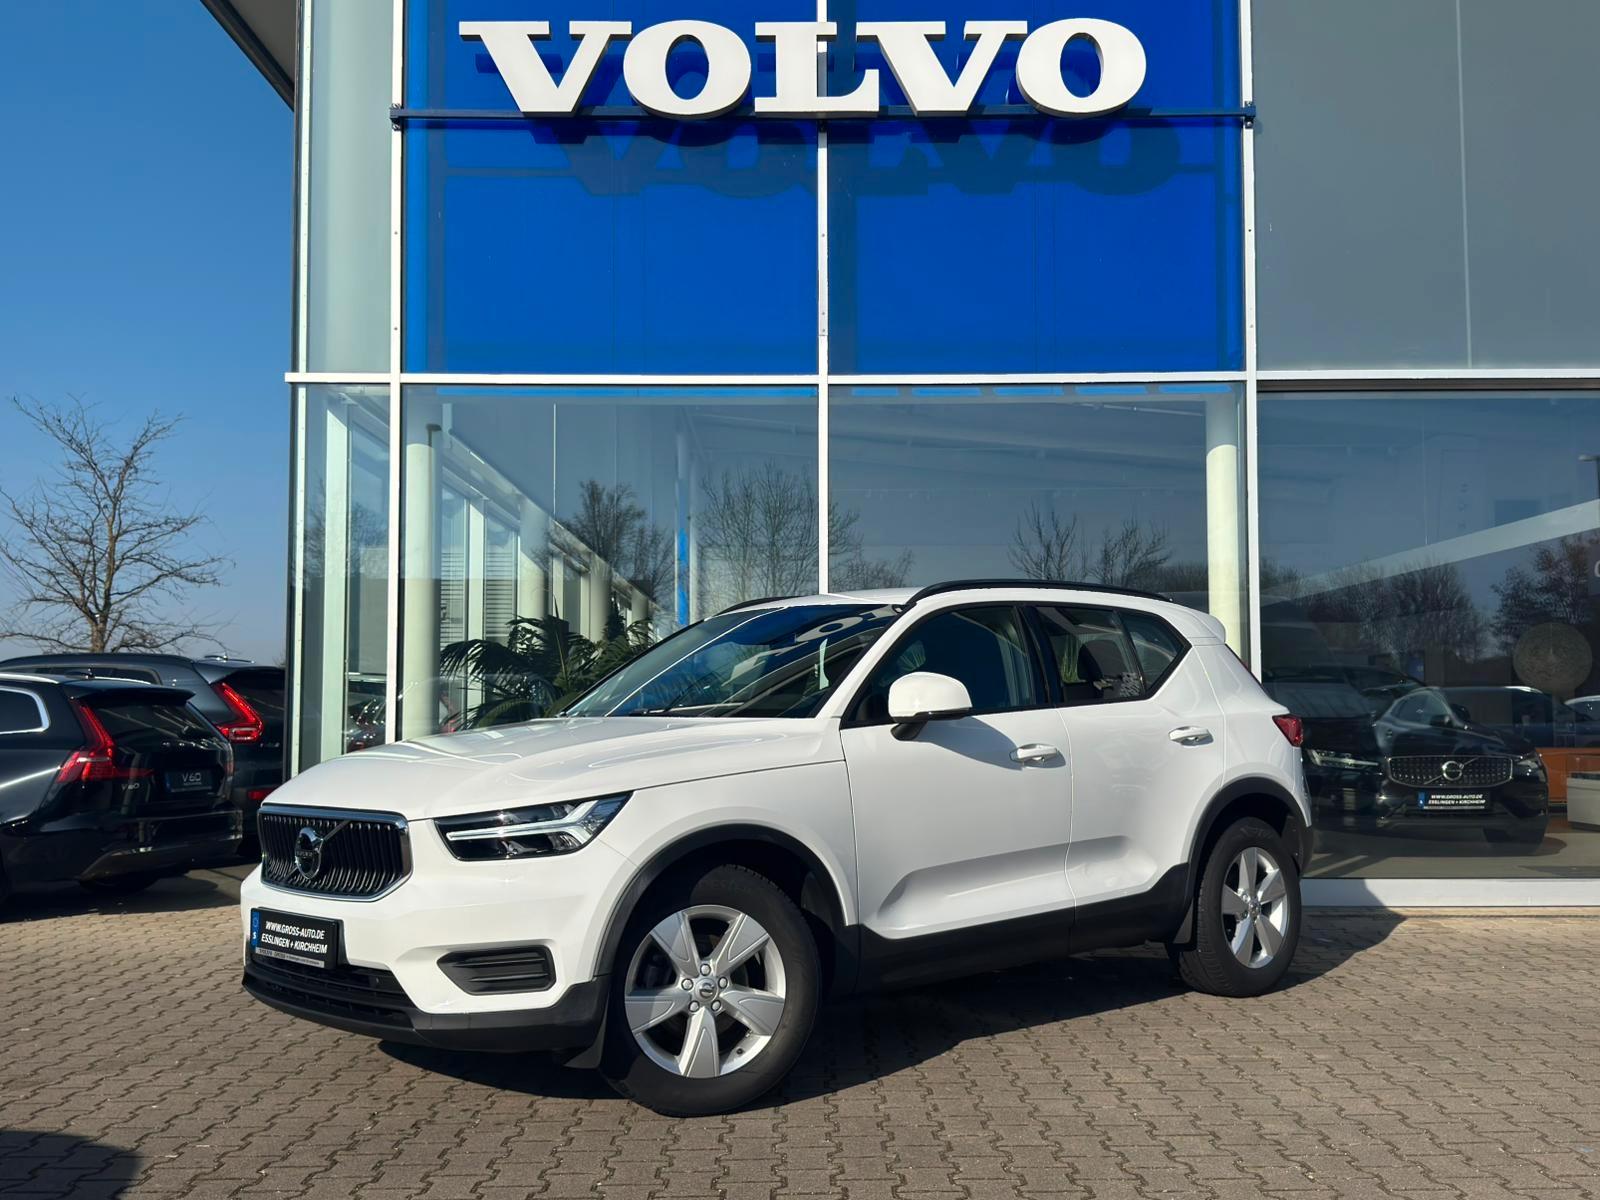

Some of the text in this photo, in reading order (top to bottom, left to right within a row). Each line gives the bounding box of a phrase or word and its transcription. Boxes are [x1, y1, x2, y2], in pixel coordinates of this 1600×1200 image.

[459, 18, 1147, 118] VOLVO
[265, 920, 325, 940] WWW.GROSS-AUTO.DE
[261, 933, 290, 949] ESSLINGEN
[293, 941, 328, 954] KIRCHHEIM
